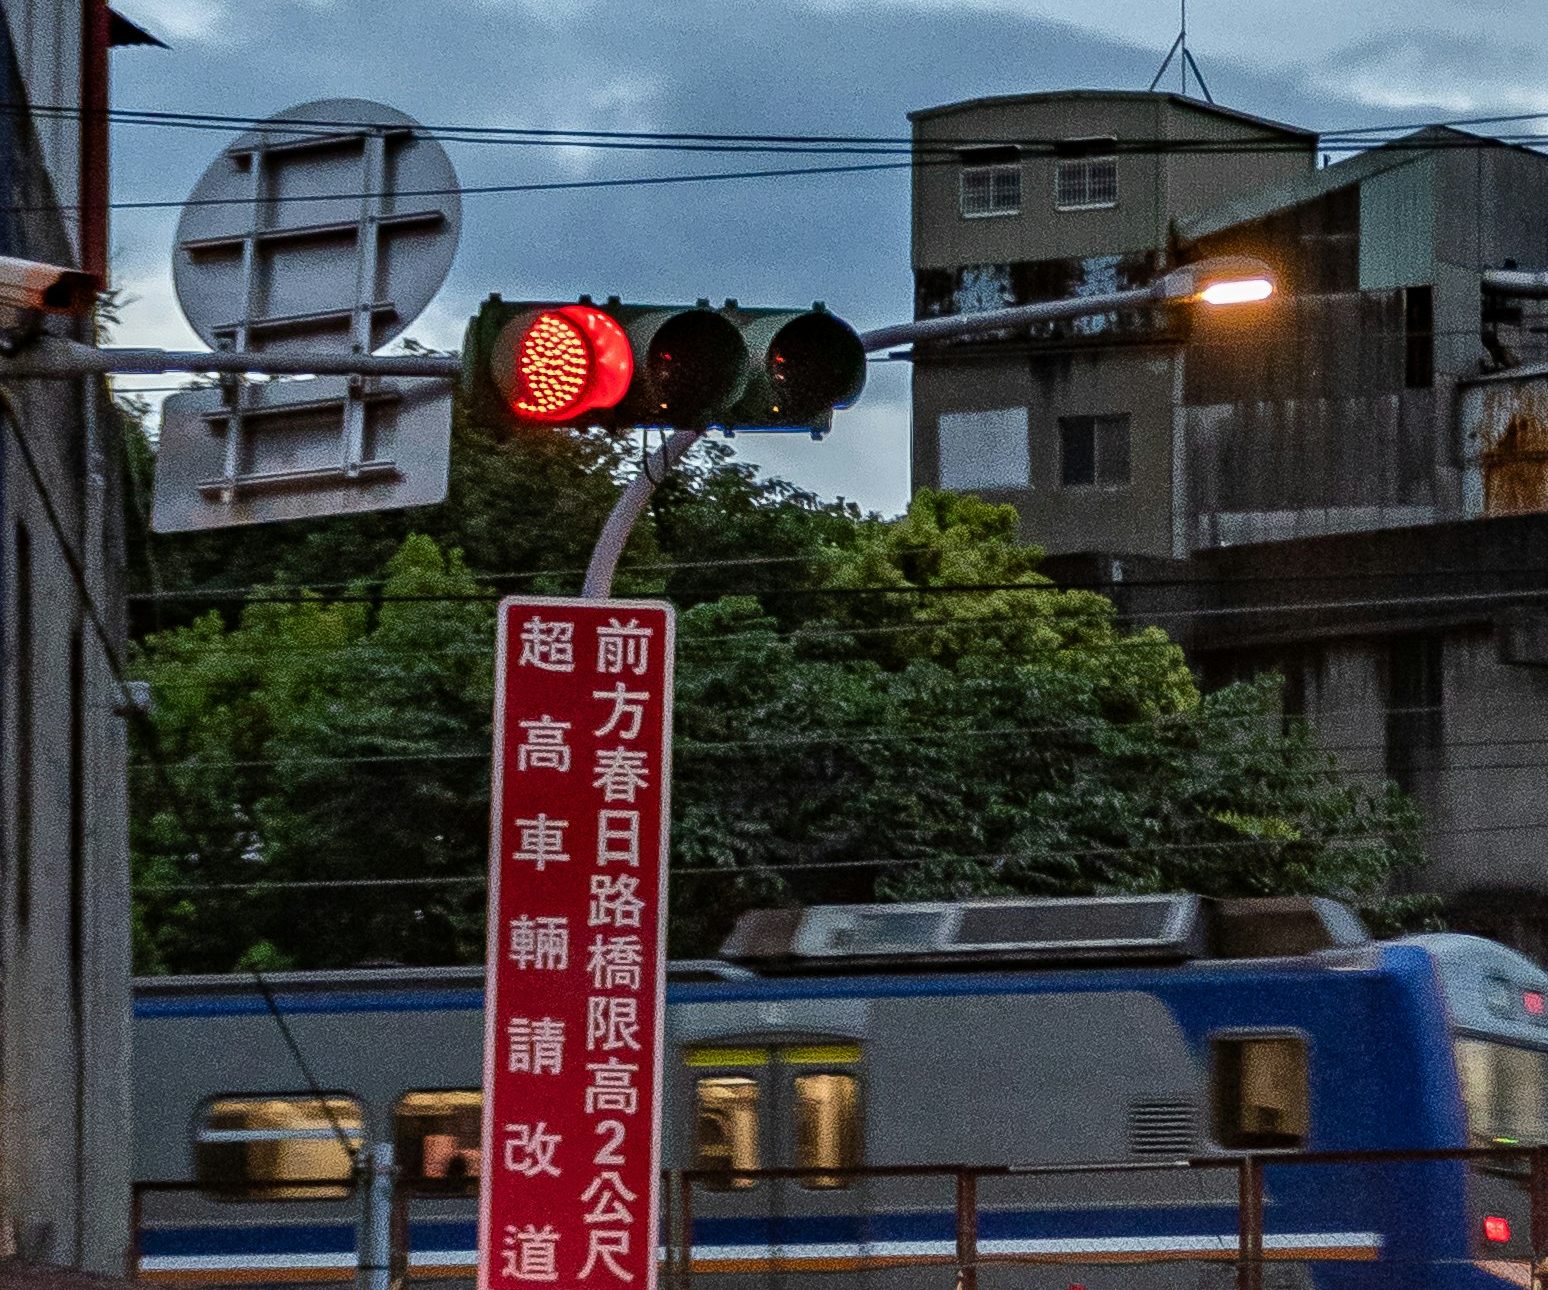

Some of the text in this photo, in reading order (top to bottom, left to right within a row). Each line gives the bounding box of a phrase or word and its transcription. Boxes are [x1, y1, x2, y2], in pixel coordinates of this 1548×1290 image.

[502, 615, 576, 1283] 超高車輛請改道
[577, 617, 653, 1282] 前方春日路橋限高2公尺
